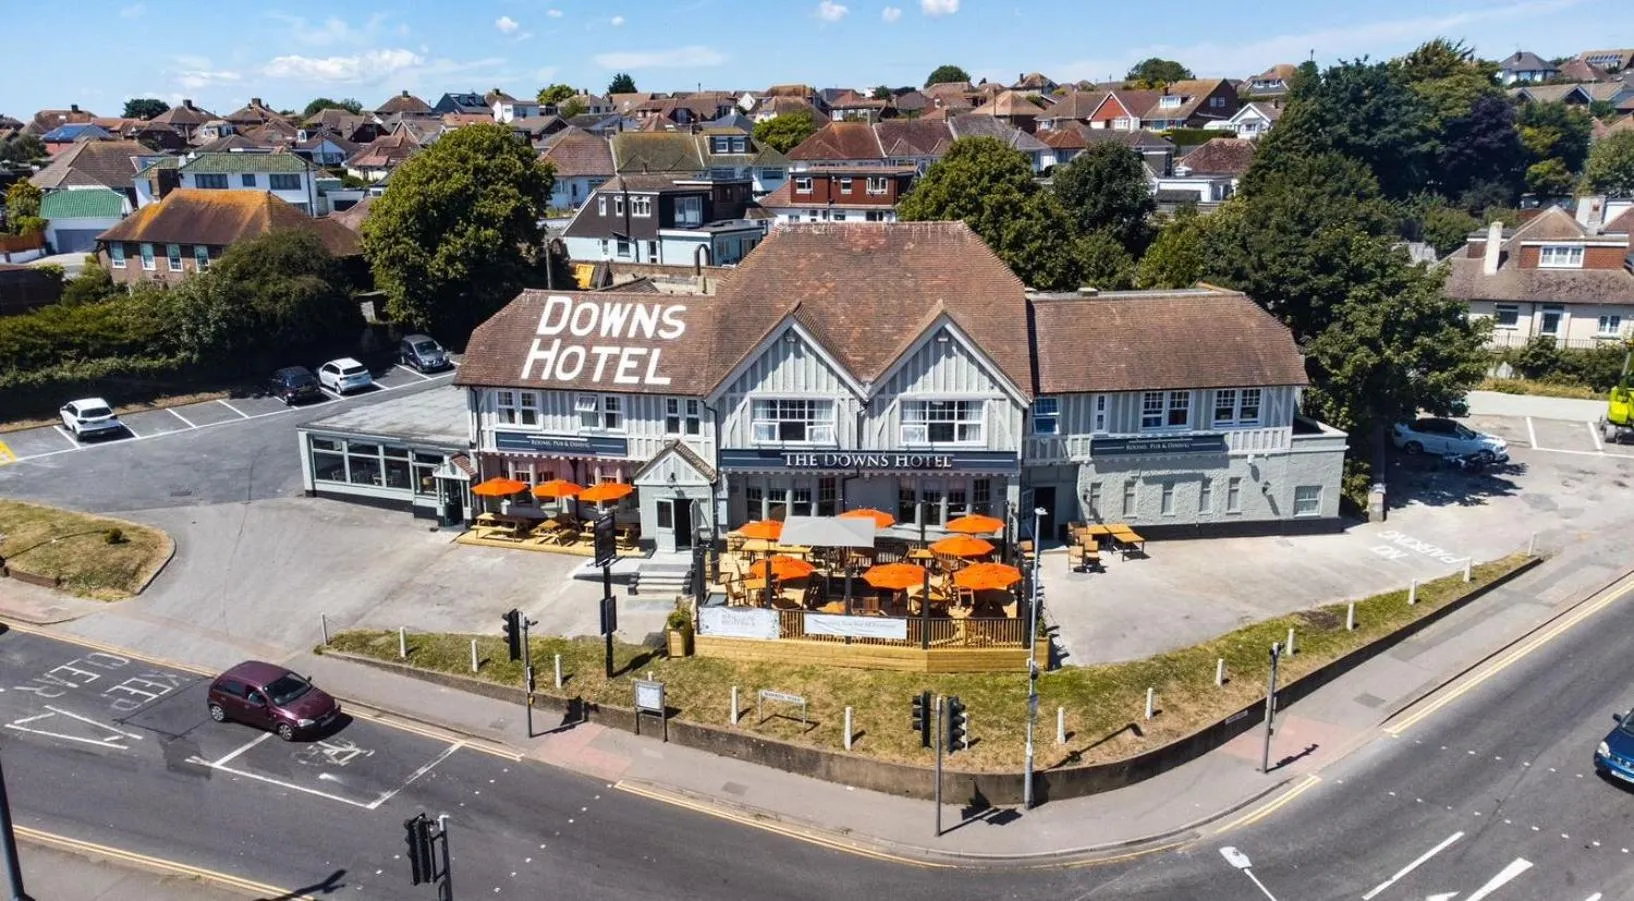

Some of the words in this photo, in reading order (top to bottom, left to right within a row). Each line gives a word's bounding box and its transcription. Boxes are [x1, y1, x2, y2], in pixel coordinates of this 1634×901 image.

[536, 295, 688, 339] DOWNS
[520, 338, 672, 385] HOTEL
[783, 452, 817, 467] THE
[824, 452, 890, 468] DOWNS
[894, 453, 952, 468] HOTEL
[13, 652, 130, 698] CLEAR
[101, 670, 191, 711] KEEP
